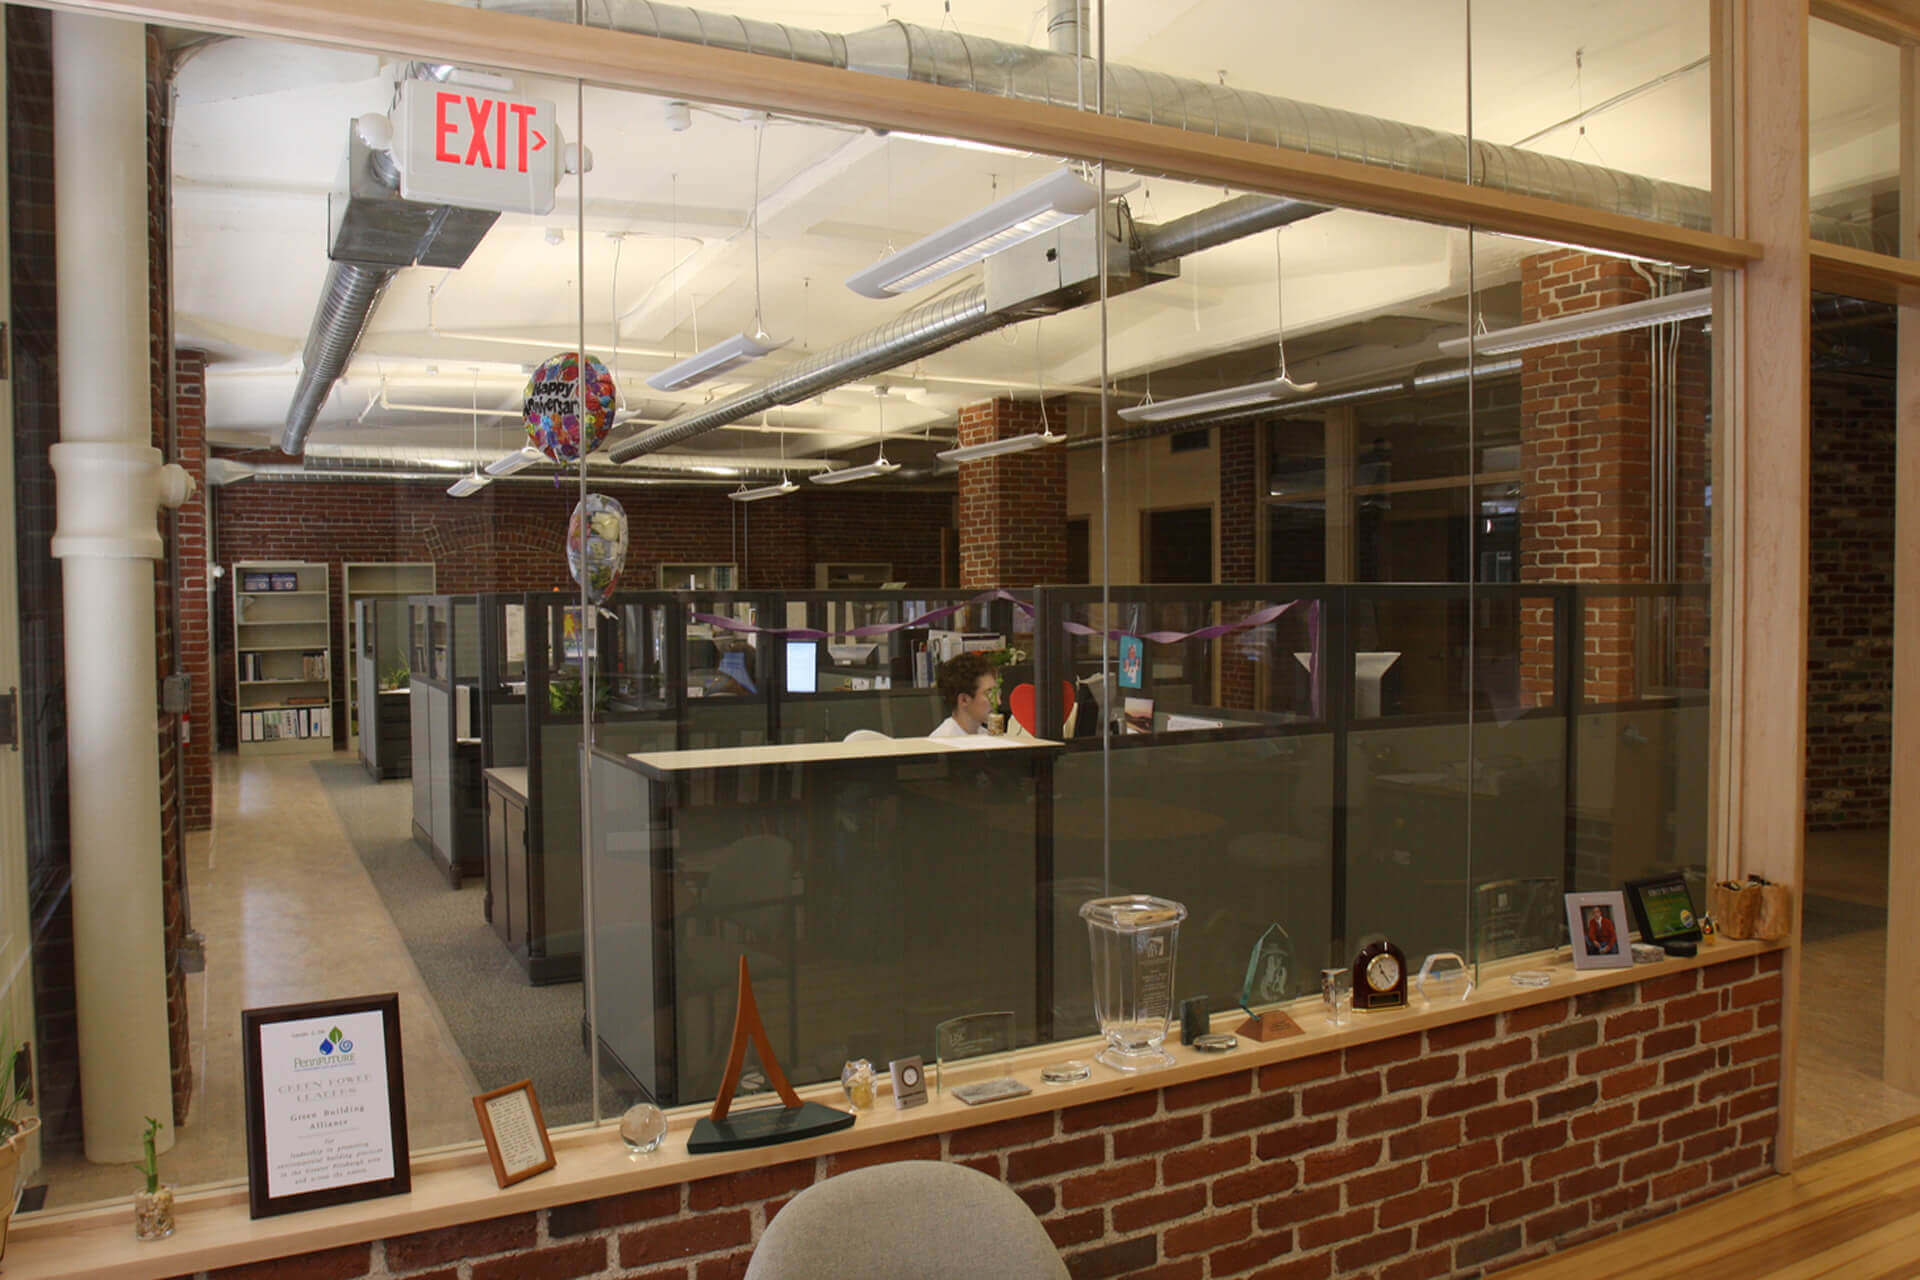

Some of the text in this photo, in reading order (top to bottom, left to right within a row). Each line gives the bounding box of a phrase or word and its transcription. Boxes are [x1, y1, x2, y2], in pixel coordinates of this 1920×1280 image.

[436, 91, 537, 173] EXIT
[532, 381, 574, 398] Happy
[290, 1105, 365, 1121] Green Building
[310, 1119, 349, 1129] Alliance
